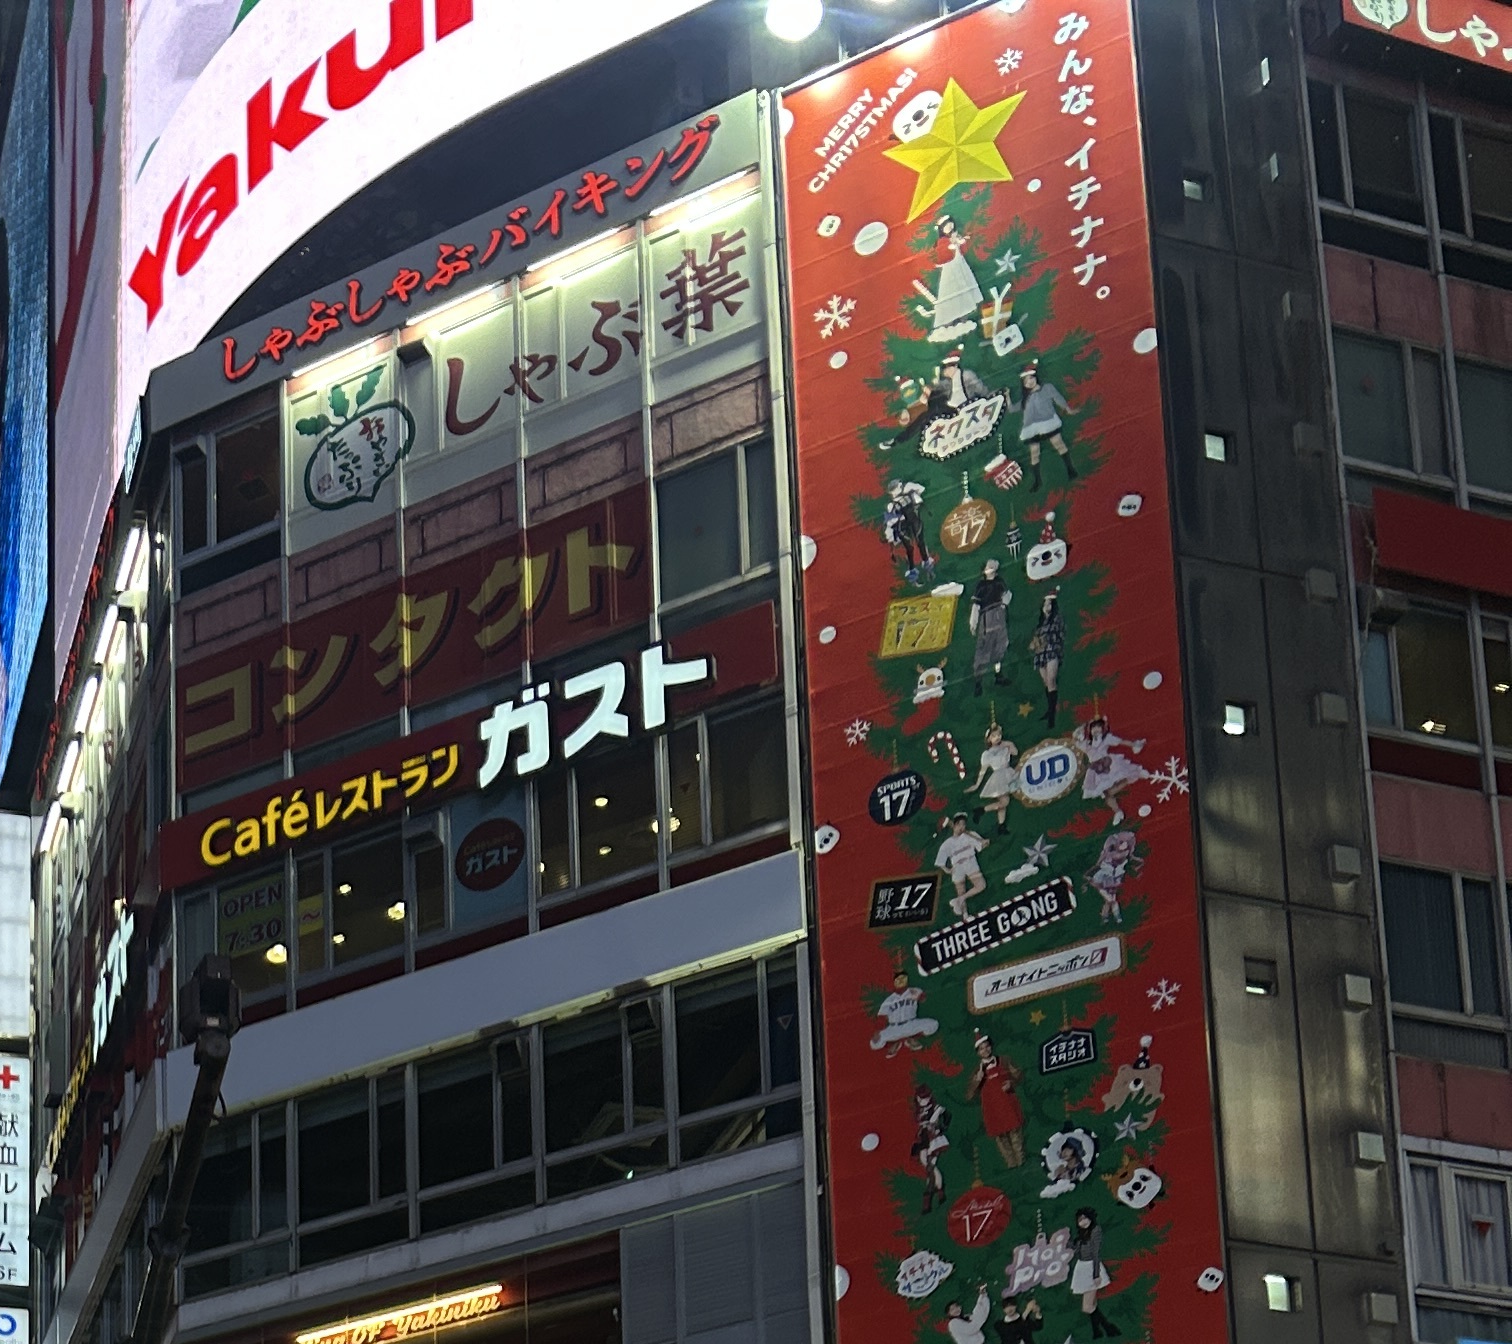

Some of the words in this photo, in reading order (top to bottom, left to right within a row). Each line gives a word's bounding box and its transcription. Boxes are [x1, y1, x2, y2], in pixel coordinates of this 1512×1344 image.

[1417, 0, 1512, 61] しゃ
[808, 67, 917, 193] CHR17STMAS!
[815, 88, 873, 157] MERRY
[128, 0, 473, 332] Yaku
[1051, 13, 1111, 301] みんな、イチナナ。
[222, 114, 721, 382] しゃぶしゃぶバイキング
[445, 227, 751, 436] しゃぶ葉
[957, 514, 989, 549] 17
[183, 527, 641, 756] コンタクト
[895, 617, 931, 650] 17
[476, 645, 711, 788] ガスト
[876, 774, 917, 797] SPORTS
[1025, 753, 1070, 786] UD
[879, 787, 912, 822] 17
[464, 844, 518, 877] ガスト
[222, 880, 284, 919] OPEN
[894, 883, 934, 910] 17
[931, 920, 992, 962] THREE
[1049, 1036, 1087, 1055] イチナナ
[1049, 1047, 1087, 1066] スタジオ
[961, 1208, 993, 1243] 17
